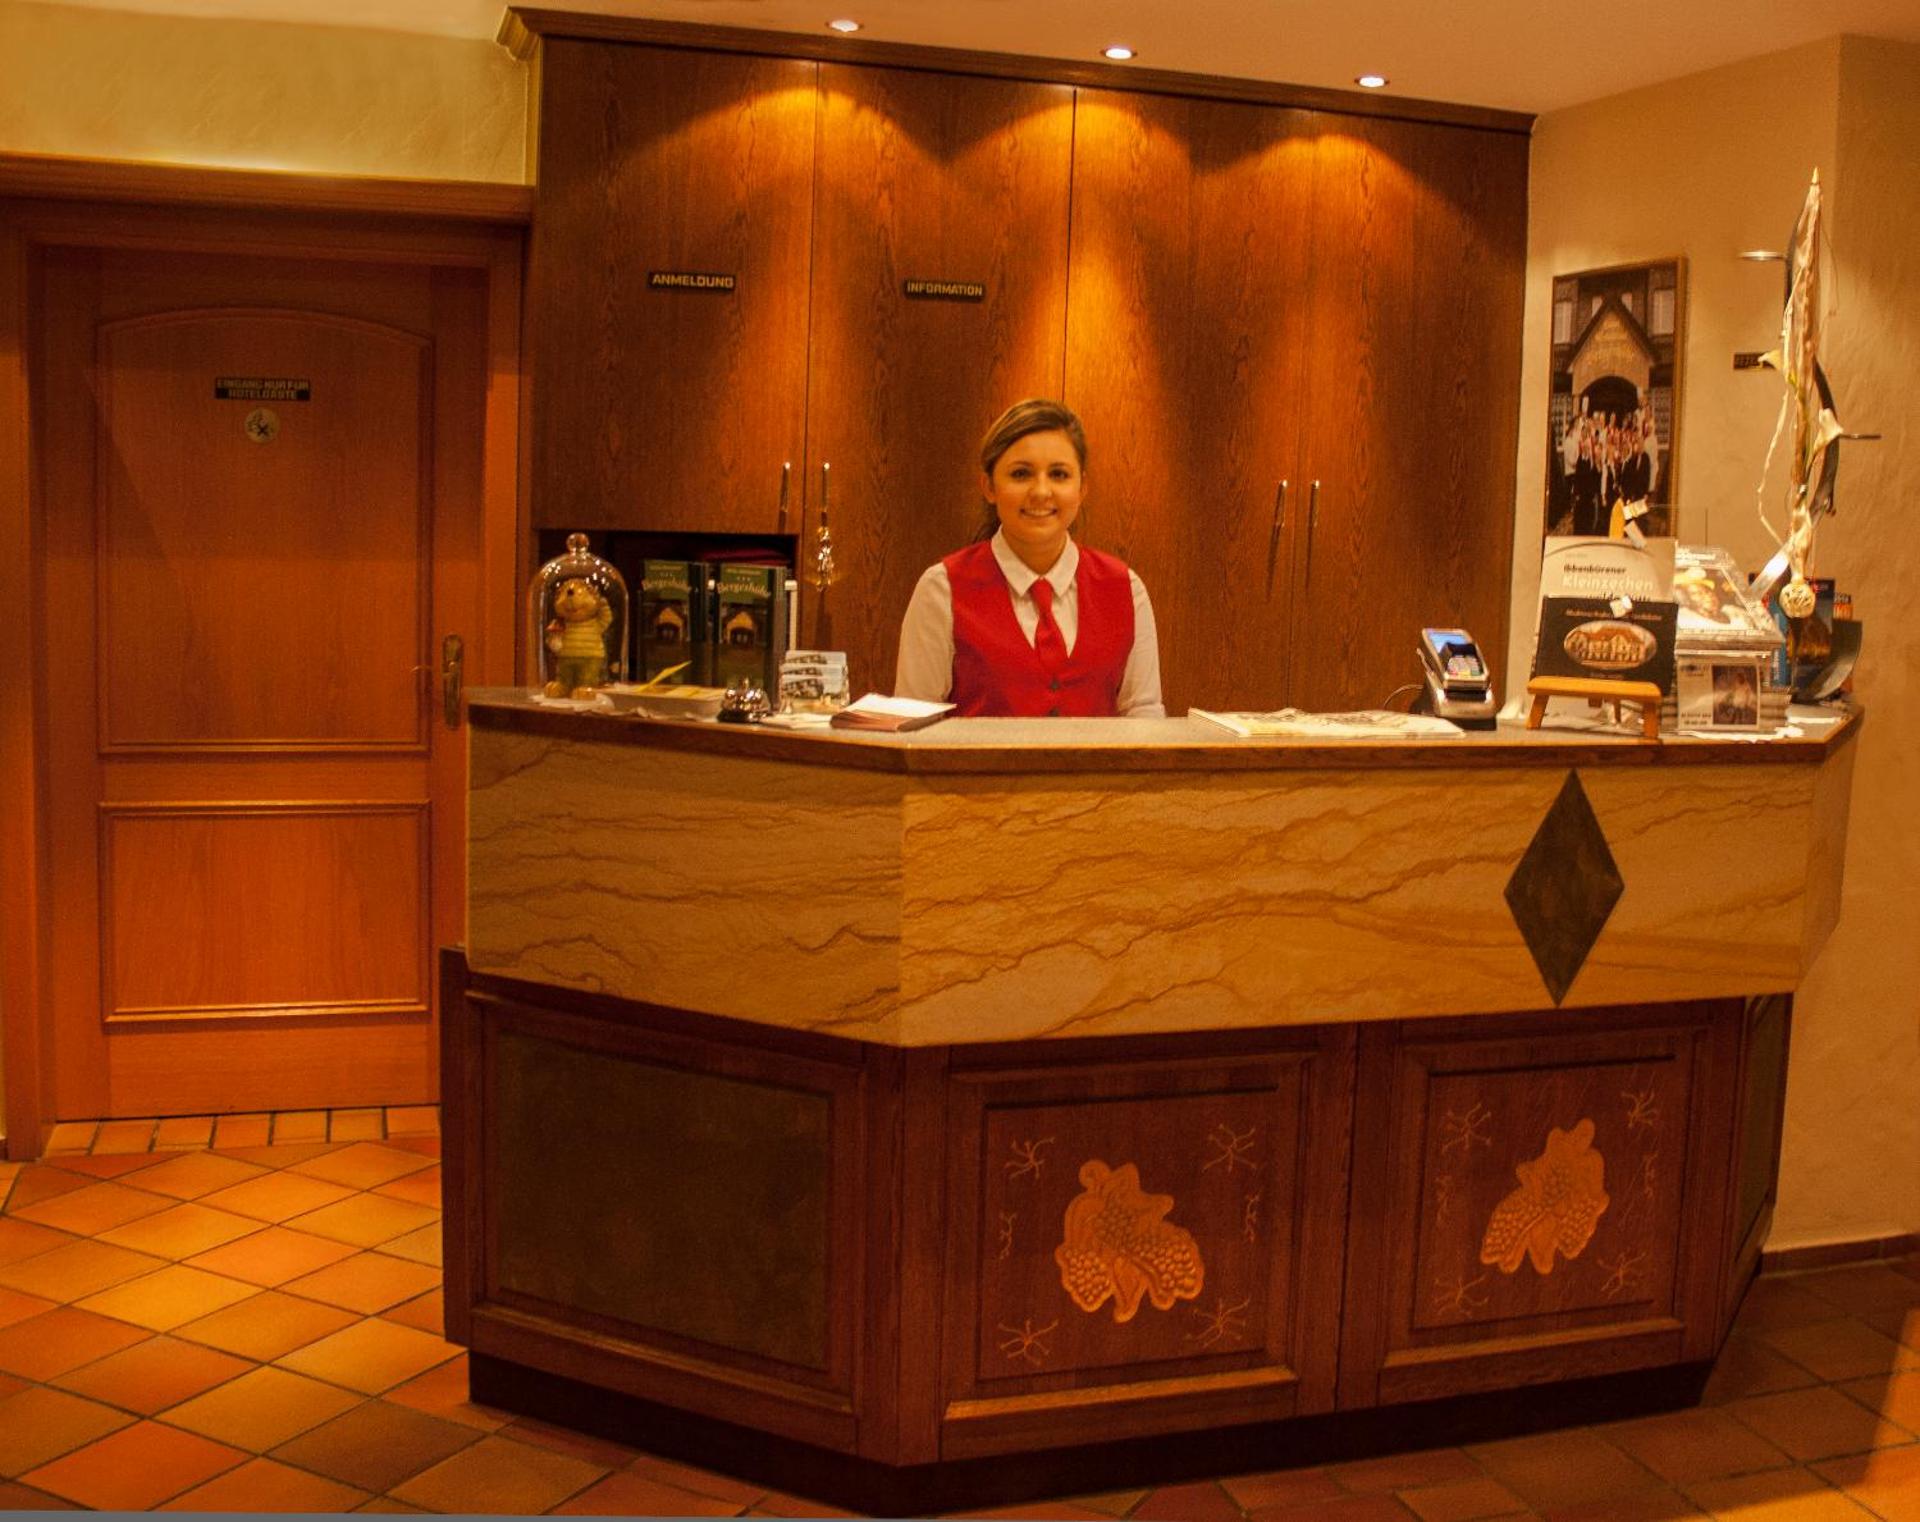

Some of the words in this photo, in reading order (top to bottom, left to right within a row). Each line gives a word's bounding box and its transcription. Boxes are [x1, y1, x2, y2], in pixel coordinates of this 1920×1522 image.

[652, 273, 734, 289] ANMELDUNG
[907, 281, 983, 297] INFORMATION
[1563, 574, 1654, 592] Kleinzechen
